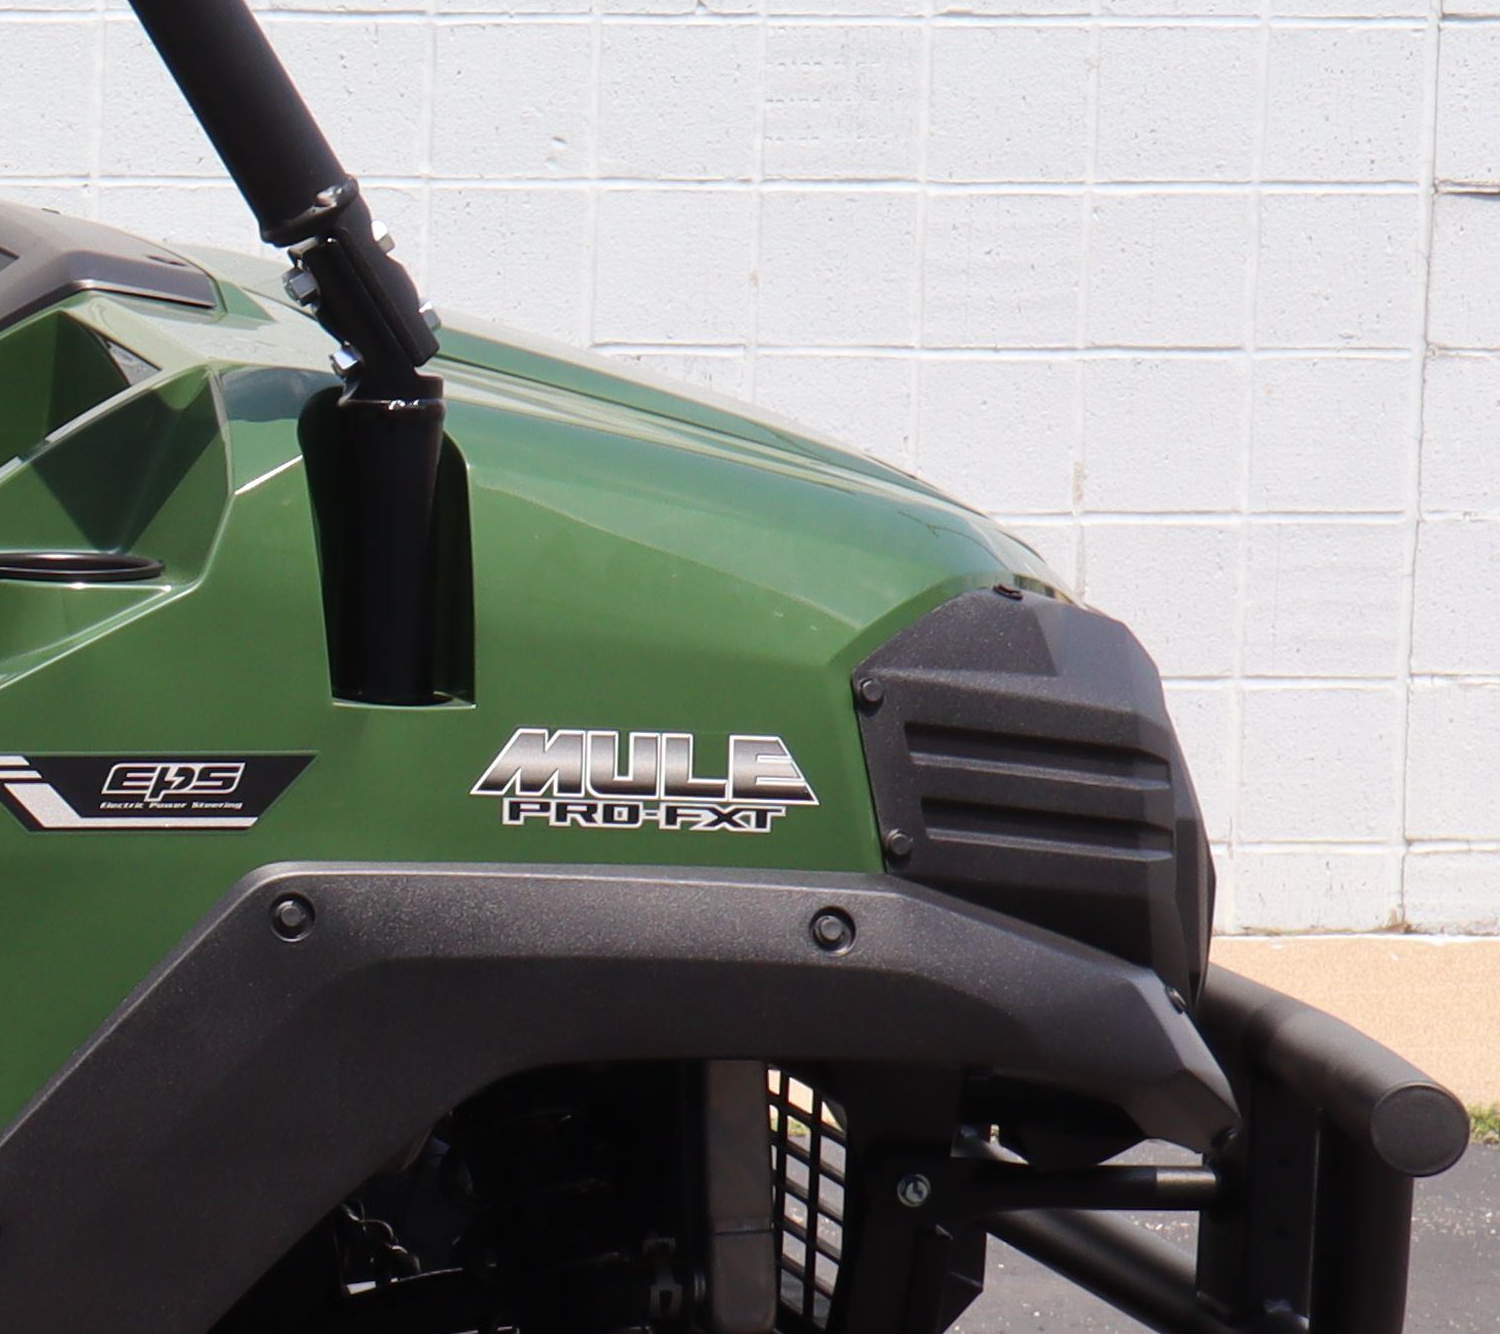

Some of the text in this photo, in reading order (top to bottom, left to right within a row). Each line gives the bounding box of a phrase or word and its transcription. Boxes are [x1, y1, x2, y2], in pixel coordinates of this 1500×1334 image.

[101, 762, 246, 802] EPS
[470, 728, 819, 805] MULE
[99, 801, 244, 810] Electric Power Steering
[503, 797, 786, 833] PRO-FXT
